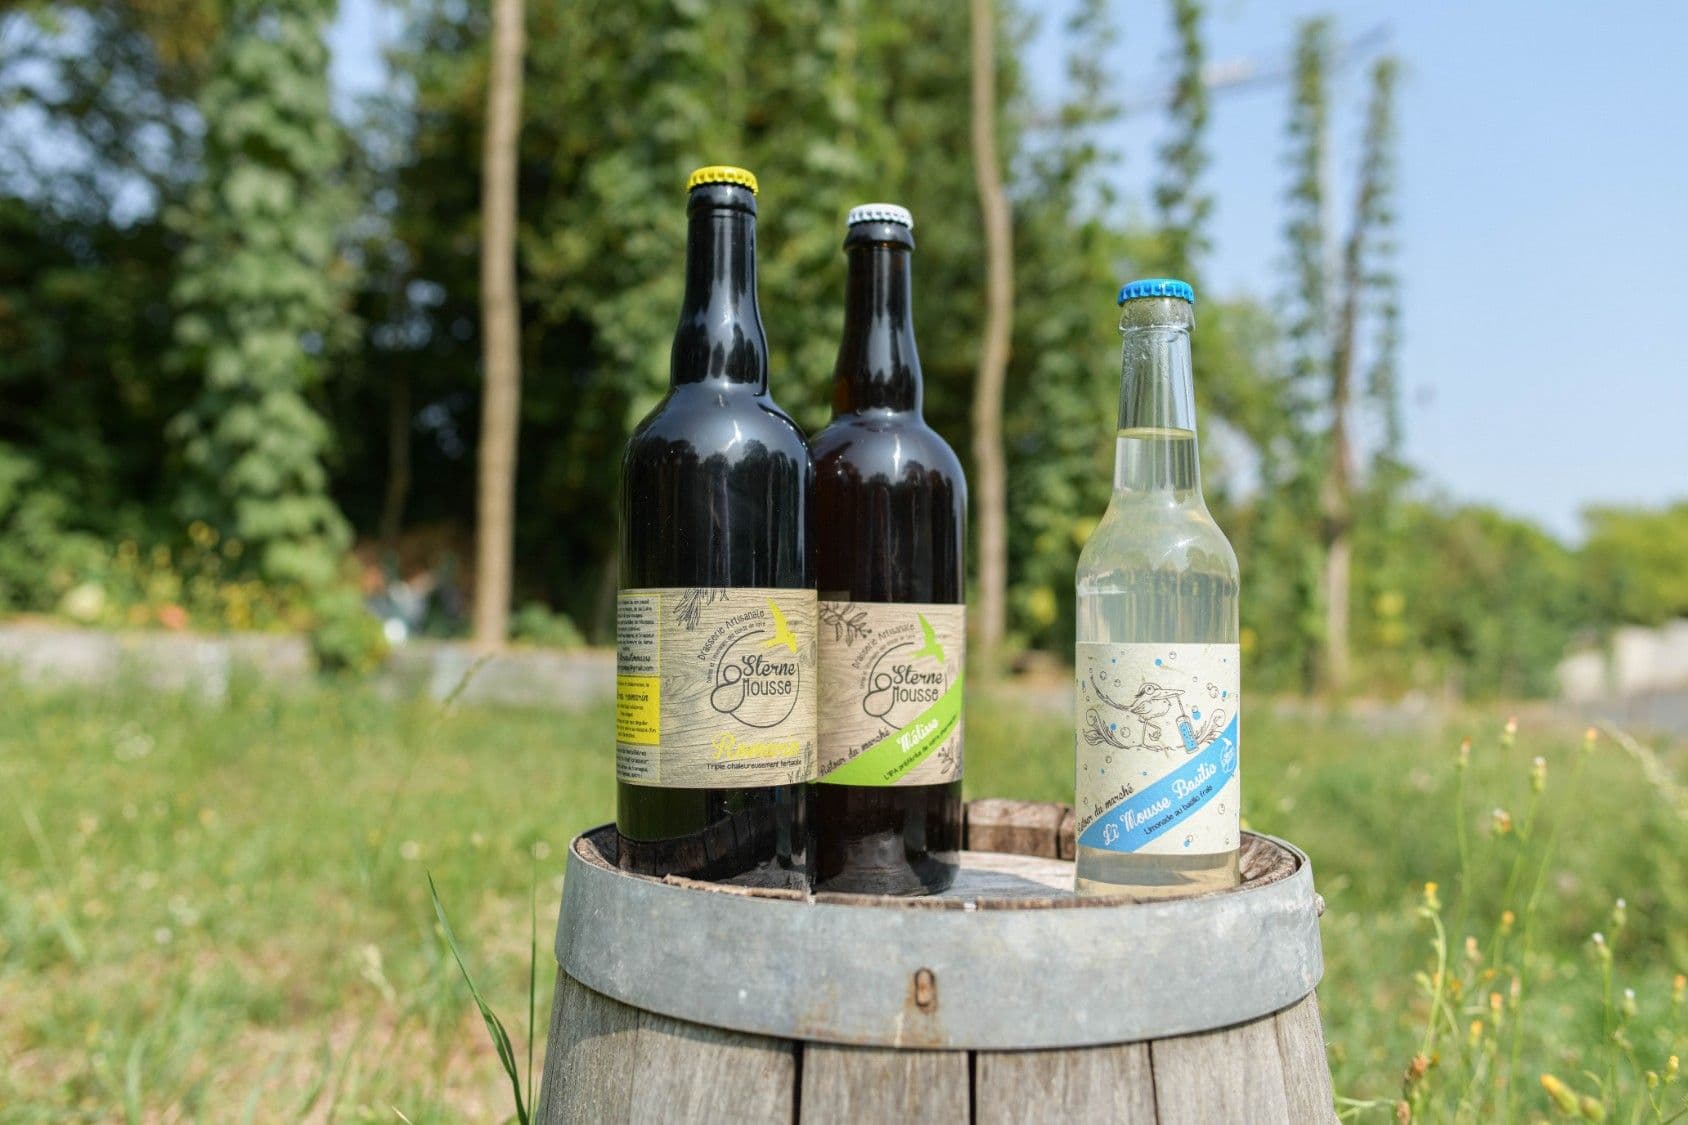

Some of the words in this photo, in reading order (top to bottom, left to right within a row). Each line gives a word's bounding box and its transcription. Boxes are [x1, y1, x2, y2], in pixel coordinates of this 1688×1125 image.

[725, 609, 765, 629] Artisanale
[742, 654, 796, 676] Sterne
[893, 664, 943, 685] Sterne
[1094, 803, 1104, 818] du
[1105, 782, 1134, 809] marché
[1119, 797, 1171, 833] Mousse
[1143, 814, 1174, 836] Limonade
